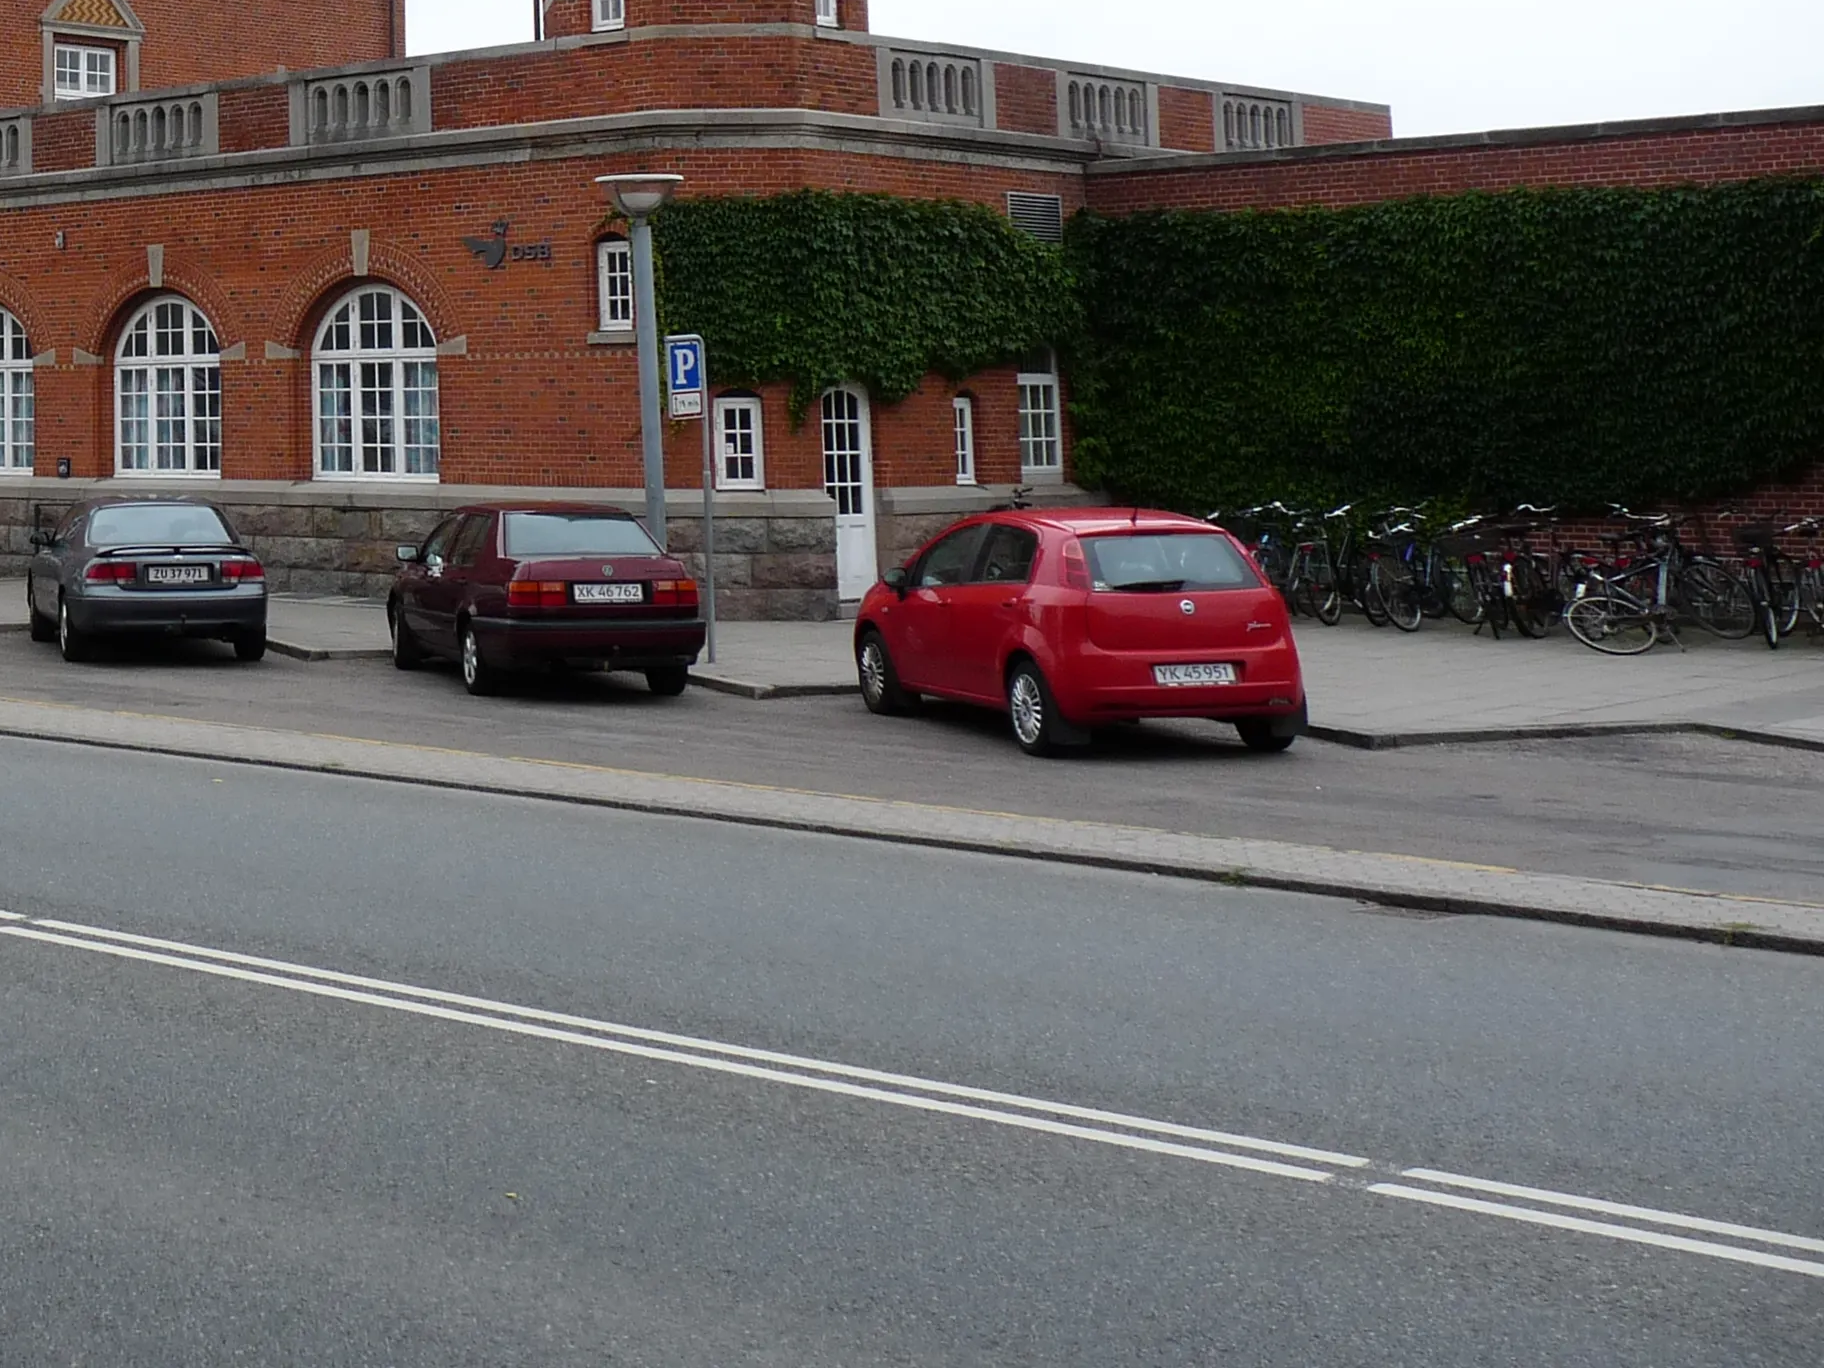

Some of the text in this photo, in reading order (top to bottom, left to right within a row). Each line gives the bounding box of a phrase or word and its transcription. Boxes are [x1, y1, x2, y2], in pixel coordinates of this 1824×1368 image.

[511, 243, 551, 260] DSB
[674, 348, 695, 385] P
[577, 586, 596, 598] XK
[1158, 667, 1180, 681] YK
